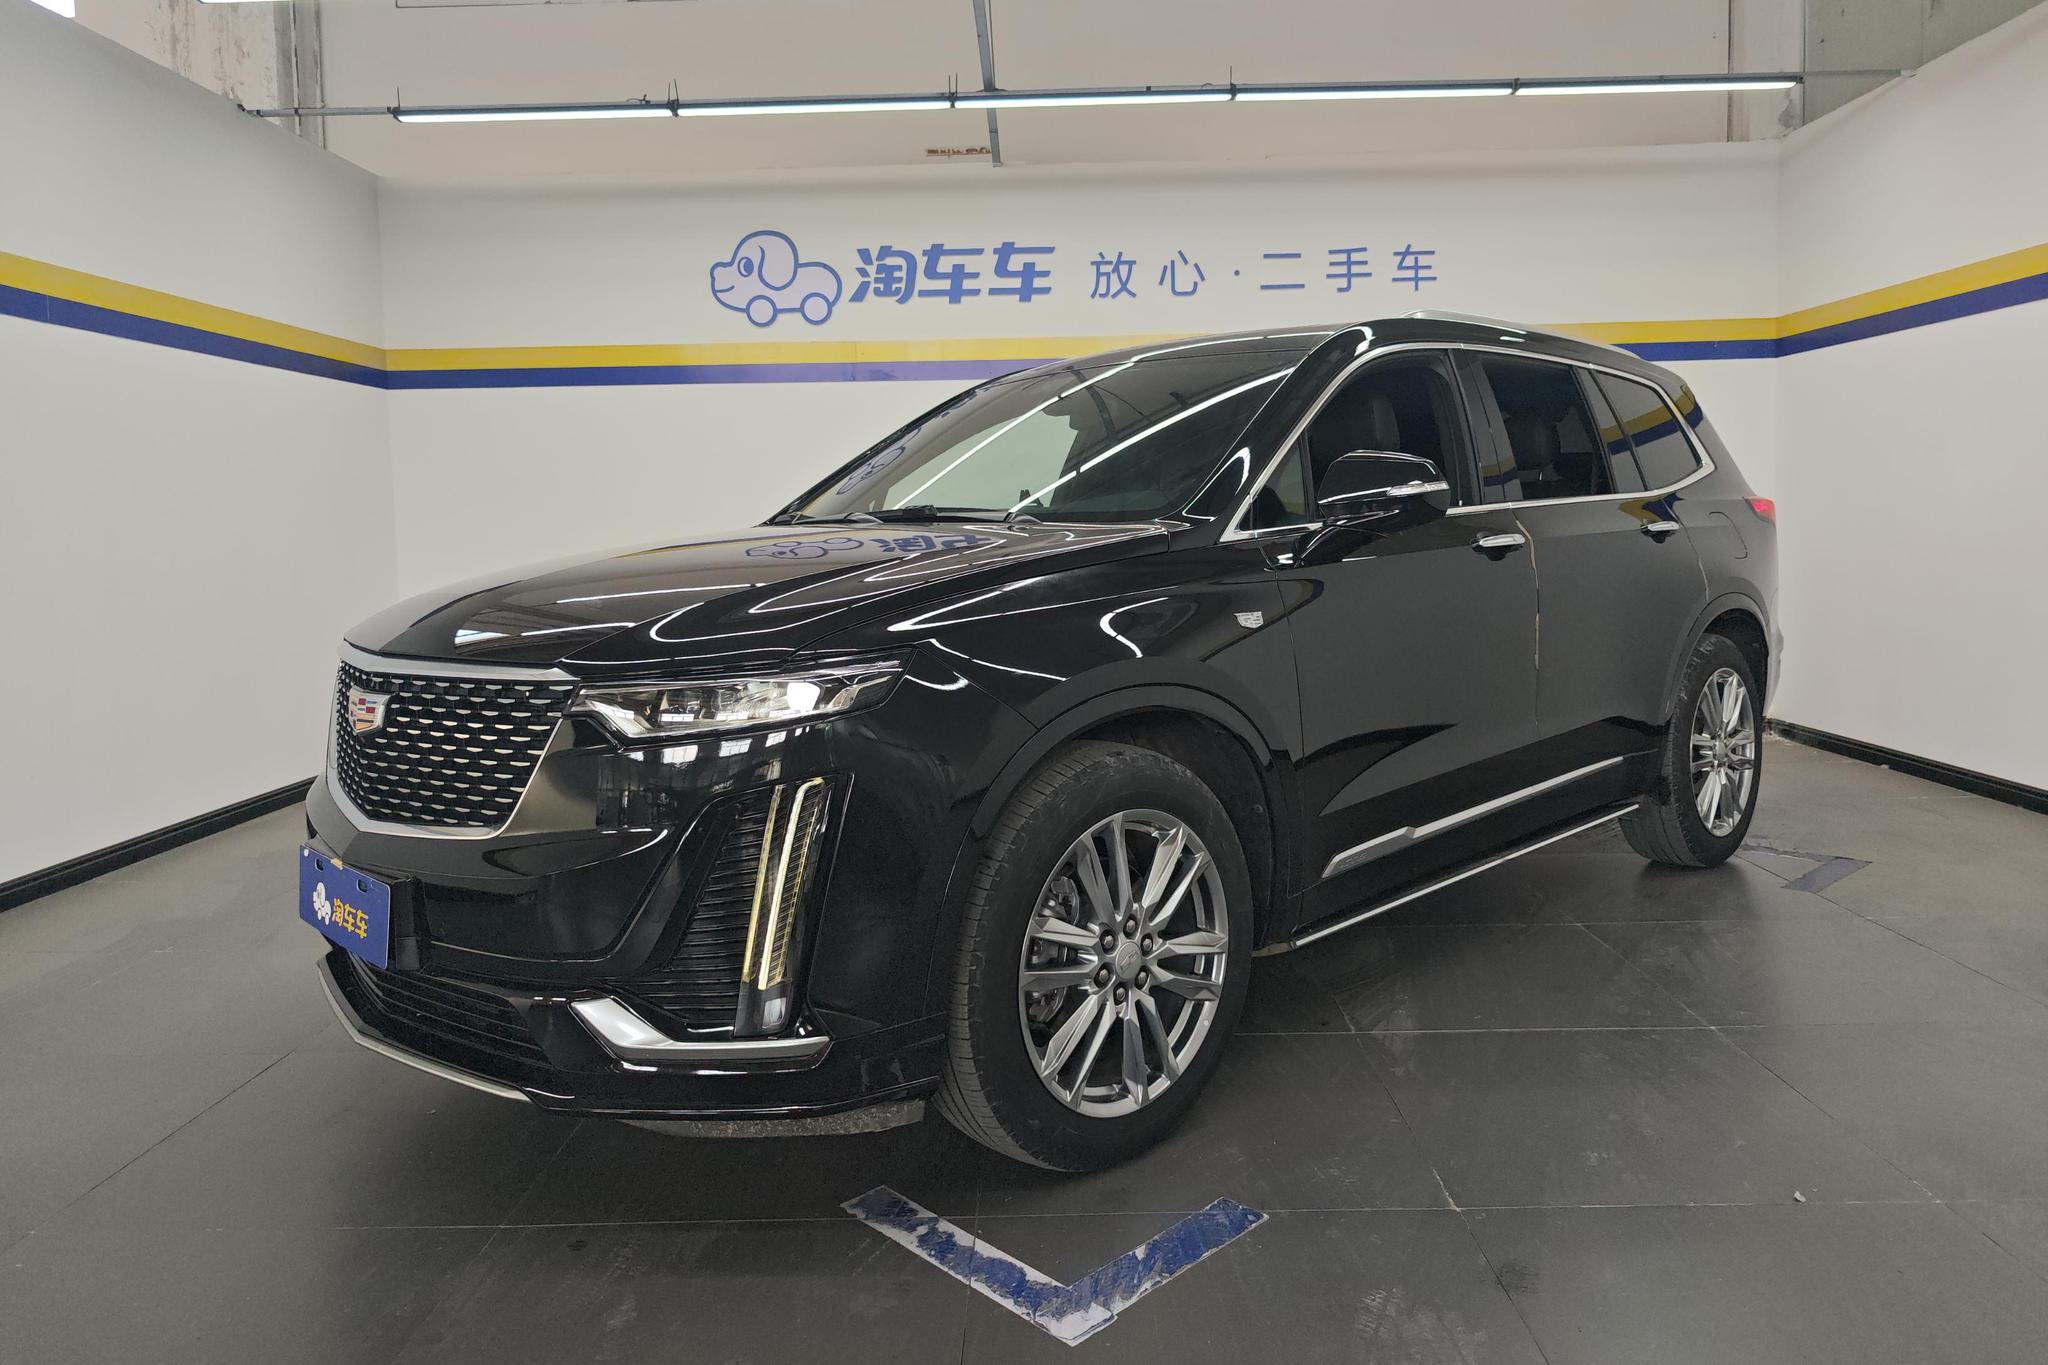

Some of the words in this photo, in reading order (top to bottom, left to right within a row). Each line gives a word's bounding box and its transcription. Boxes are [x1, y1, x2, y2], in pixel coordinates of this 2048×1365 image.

[850, 242, 1056, 305] 淘车车
[332, 898, 368, 939] 淘车车
